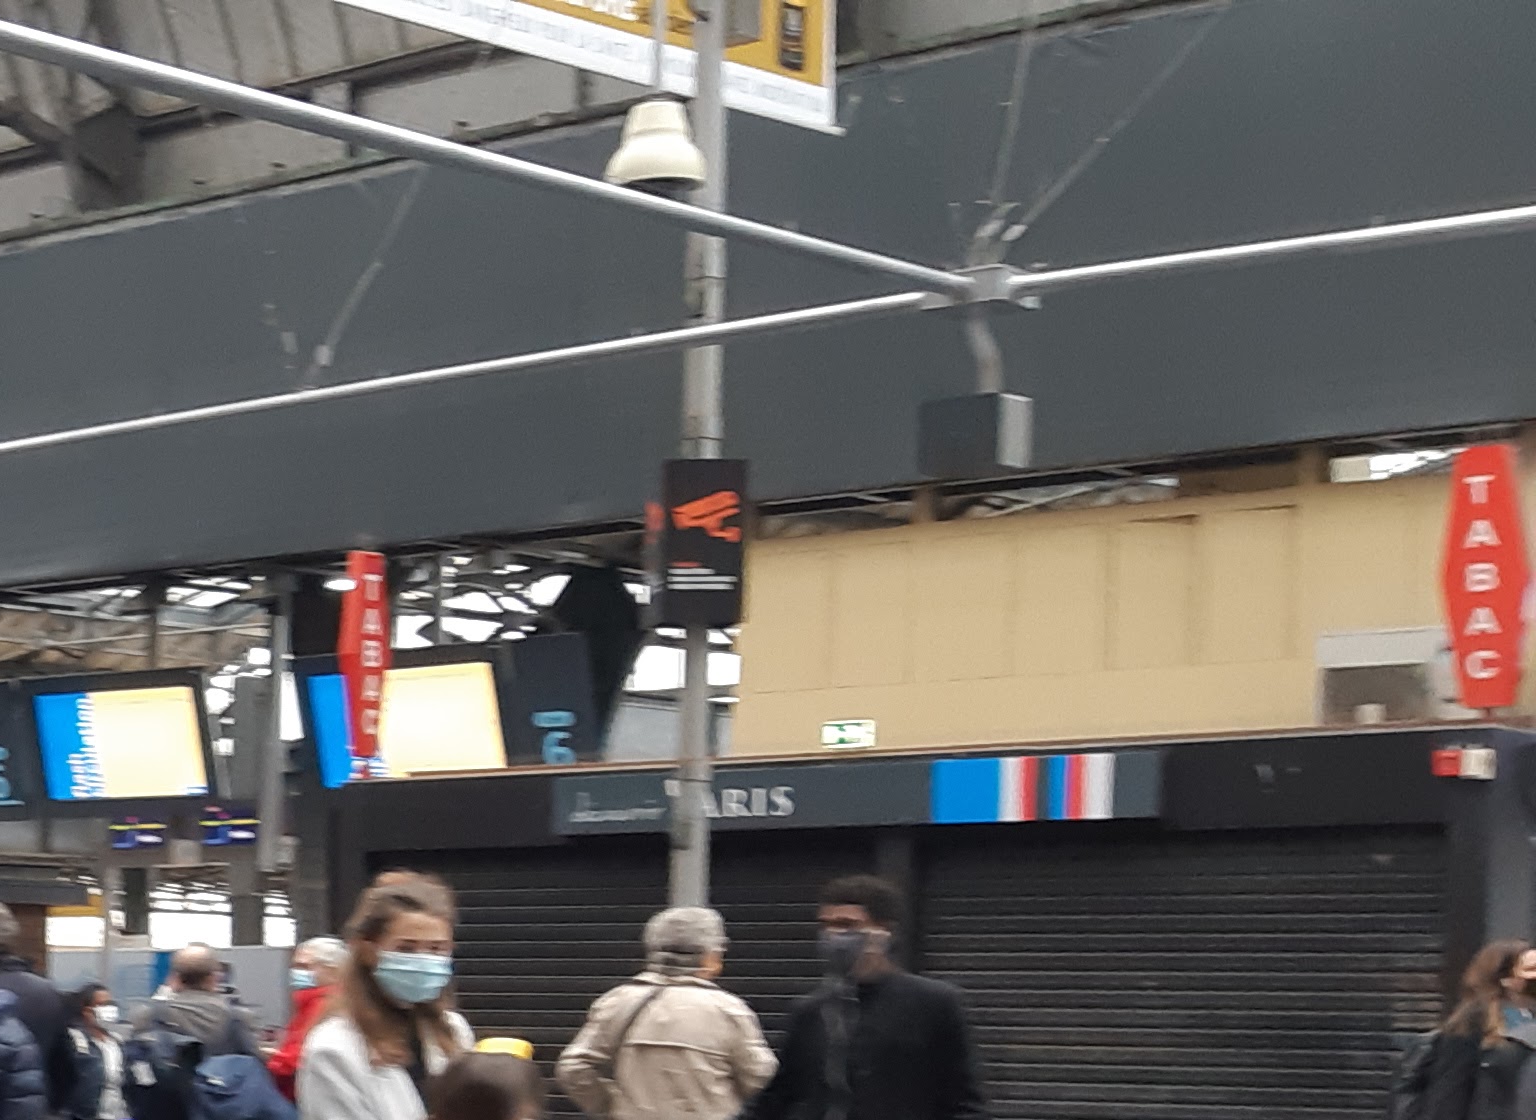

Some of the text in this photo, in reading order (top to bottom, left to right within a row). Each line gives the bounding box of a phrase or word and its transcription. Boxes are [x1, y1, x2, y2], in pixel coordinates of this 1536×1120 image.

[1462, 473, 1503, 680] TABAC
[360, 573, 384, 735] TABAC
[542, 731, 575, 765] 6
[665, 778, 796, 818] ARIS
